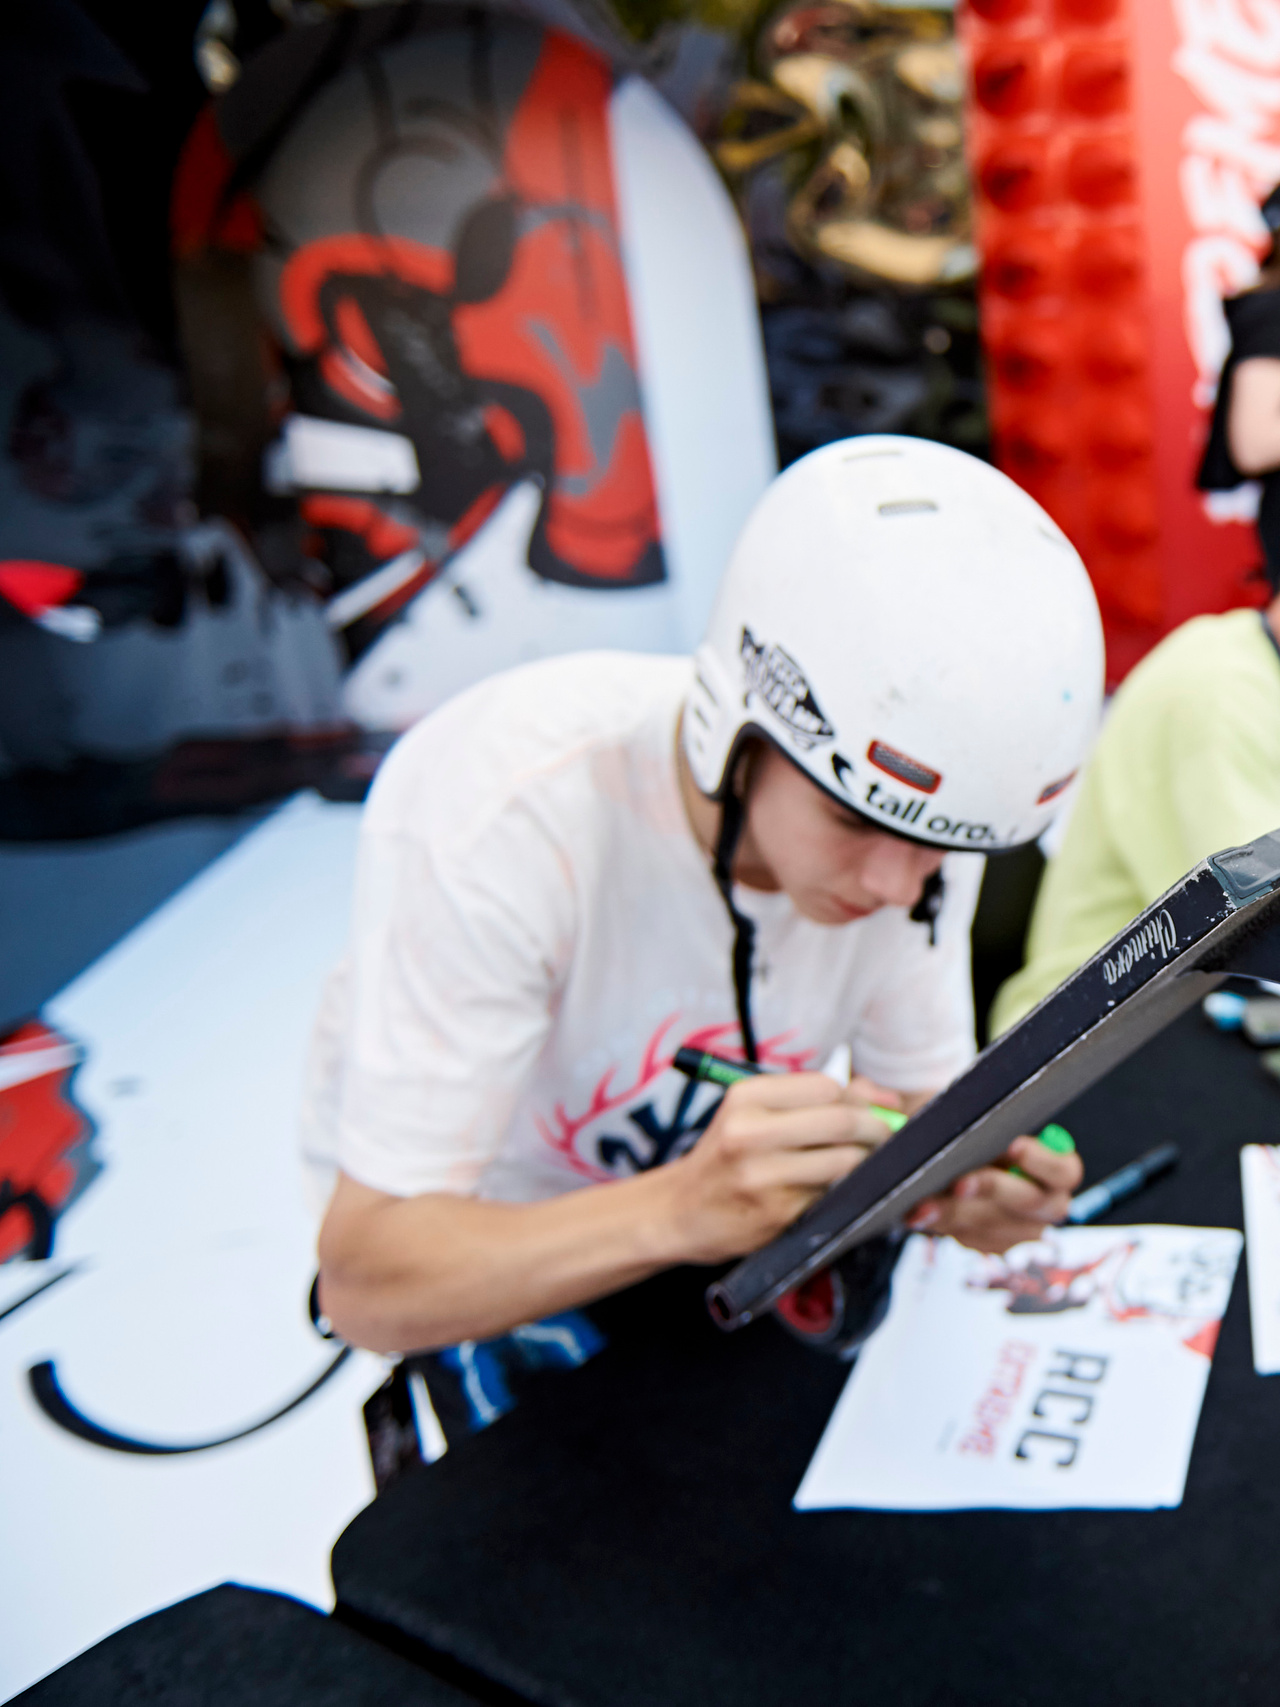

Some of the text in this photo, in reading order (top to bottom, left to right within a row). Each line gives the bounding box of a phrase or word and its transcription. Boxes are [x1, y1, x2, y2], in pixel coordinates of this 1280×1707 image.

[866, 783, 926, 824] tall
[1103, 909, 1178, 985] Chimera
[1012, 1348, 1110, 1470] RCC
